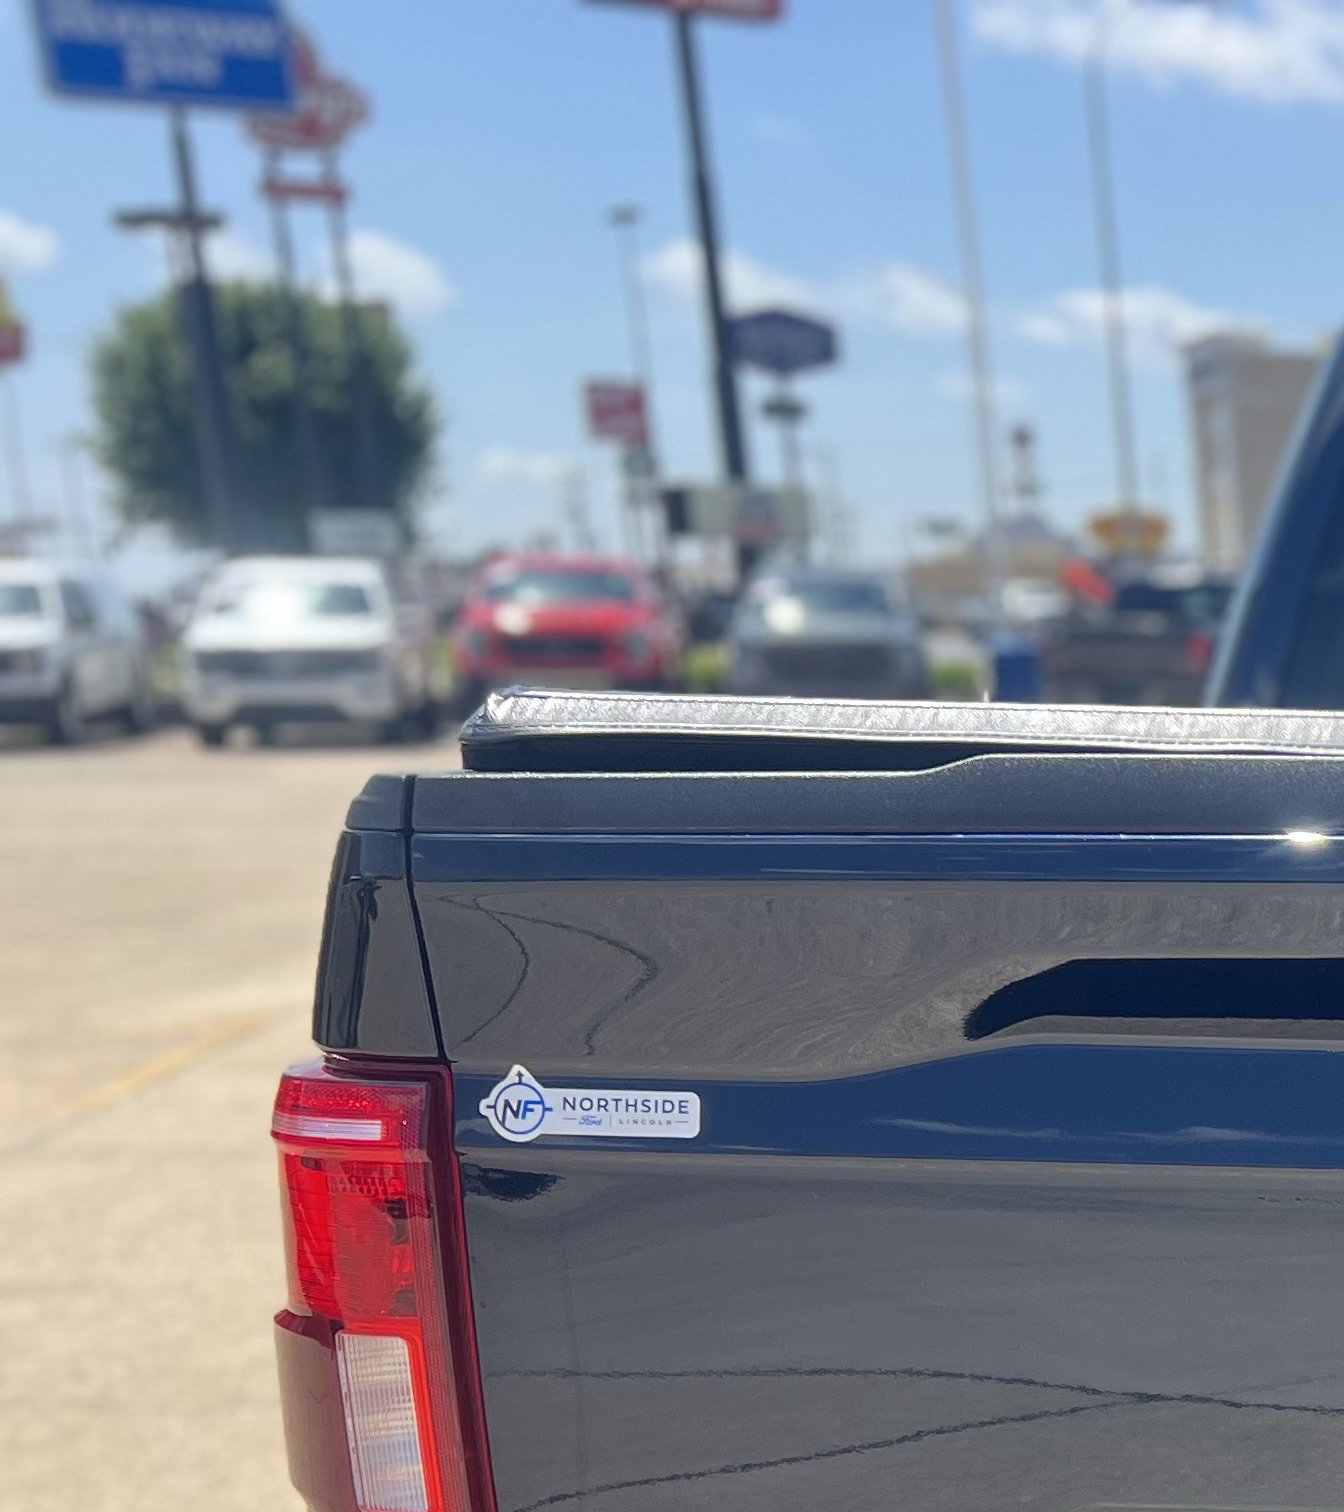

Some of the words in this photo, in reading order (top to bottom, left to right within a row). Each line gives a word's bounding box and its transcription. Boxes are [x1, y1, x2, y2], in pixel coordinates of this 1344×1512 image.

[503, 1099, 543, 1127] NF
[563, 1097, 689, 1113] NORTHSIDE
[619, 1118, 671, 1126] LINCOLN
